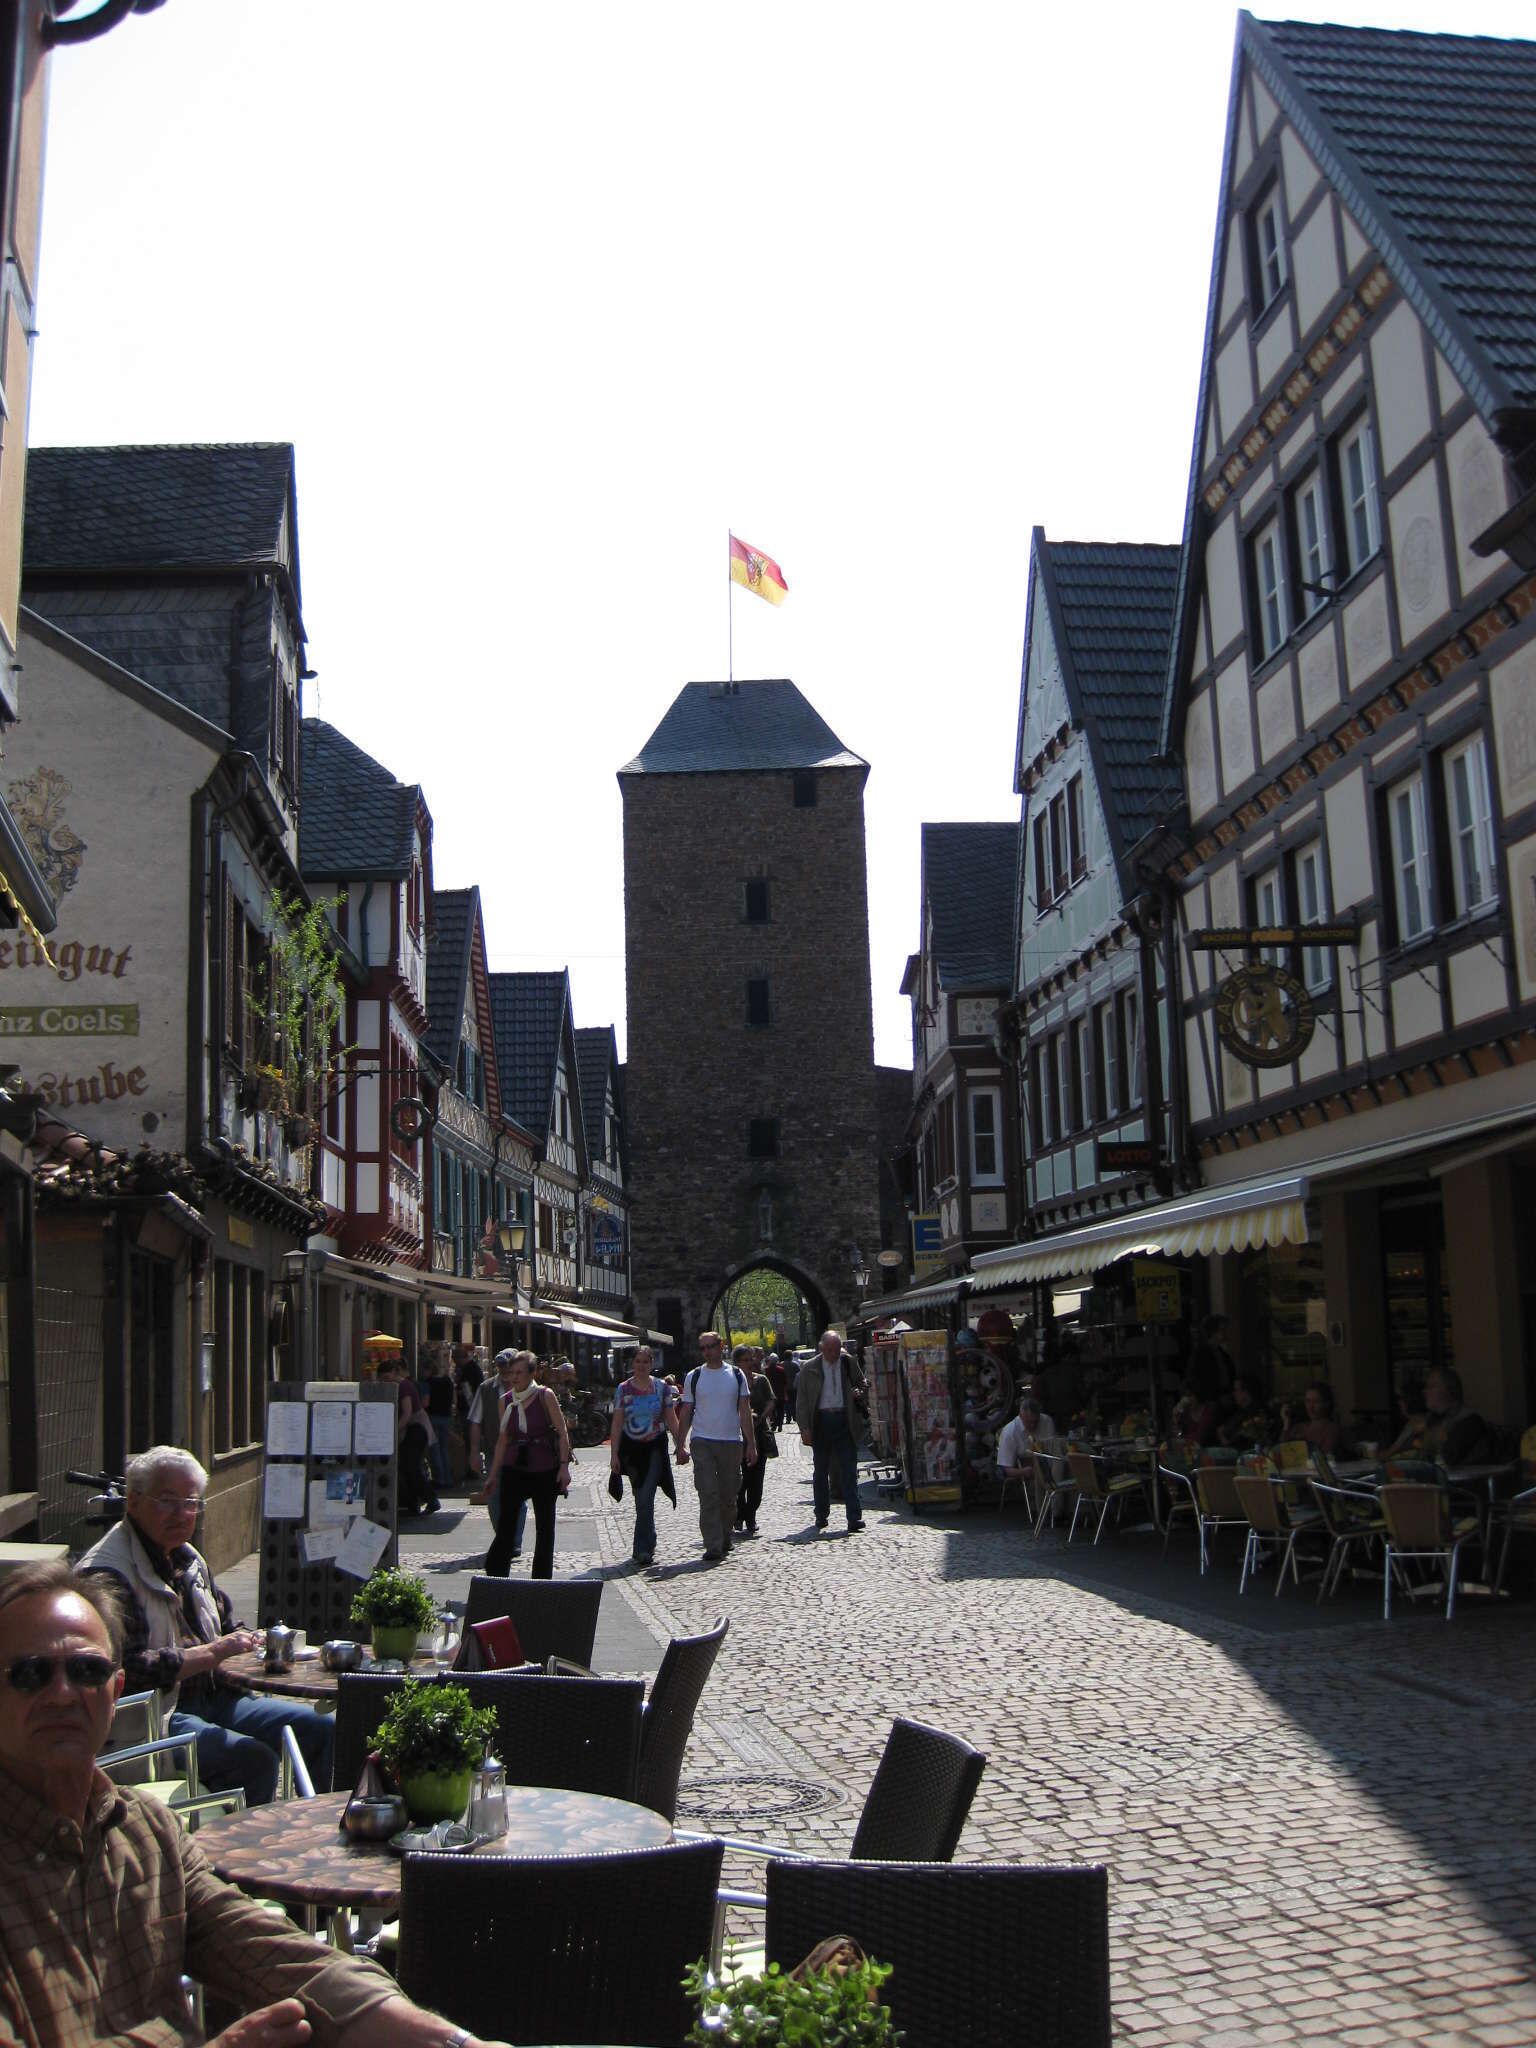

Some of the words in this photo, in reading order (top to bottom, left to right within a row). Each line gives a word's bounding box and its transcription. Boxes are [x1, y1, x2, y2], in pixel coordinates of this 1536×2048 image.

[0, 930, 133, 982] eingut
[40, 1008, 125, 1033] Coels
[1272, 968, 1314, 1035] BERLIN
[22, 1062, 150, 1109] stube
[1106, 1149, 1153, 1164] LOTTO
